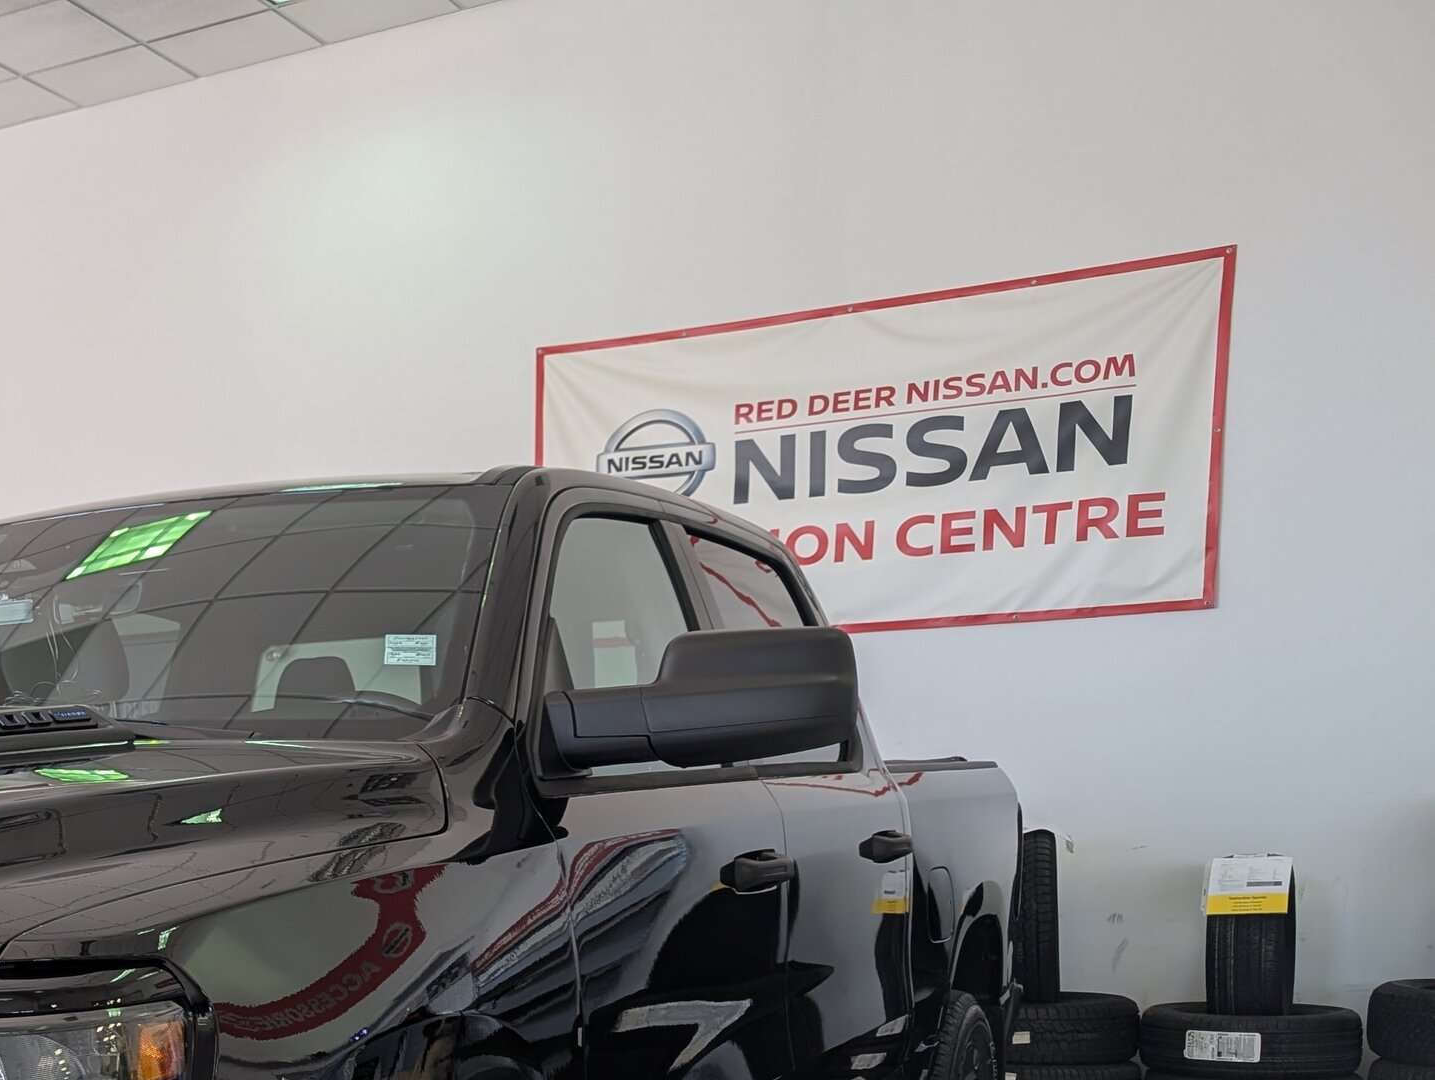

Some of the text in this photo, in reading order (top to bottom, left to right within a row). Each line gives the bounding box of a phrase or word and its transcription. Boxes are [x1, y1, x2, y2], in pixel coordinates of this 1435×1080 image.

[734, 353, 1136, 425] RED DEER NISSAN.COM
[607, 450, 703, 474] NISSAN
[733, 394, 1134, 505] NISSAN
[895, 492, 1167, 557] CENTRE
